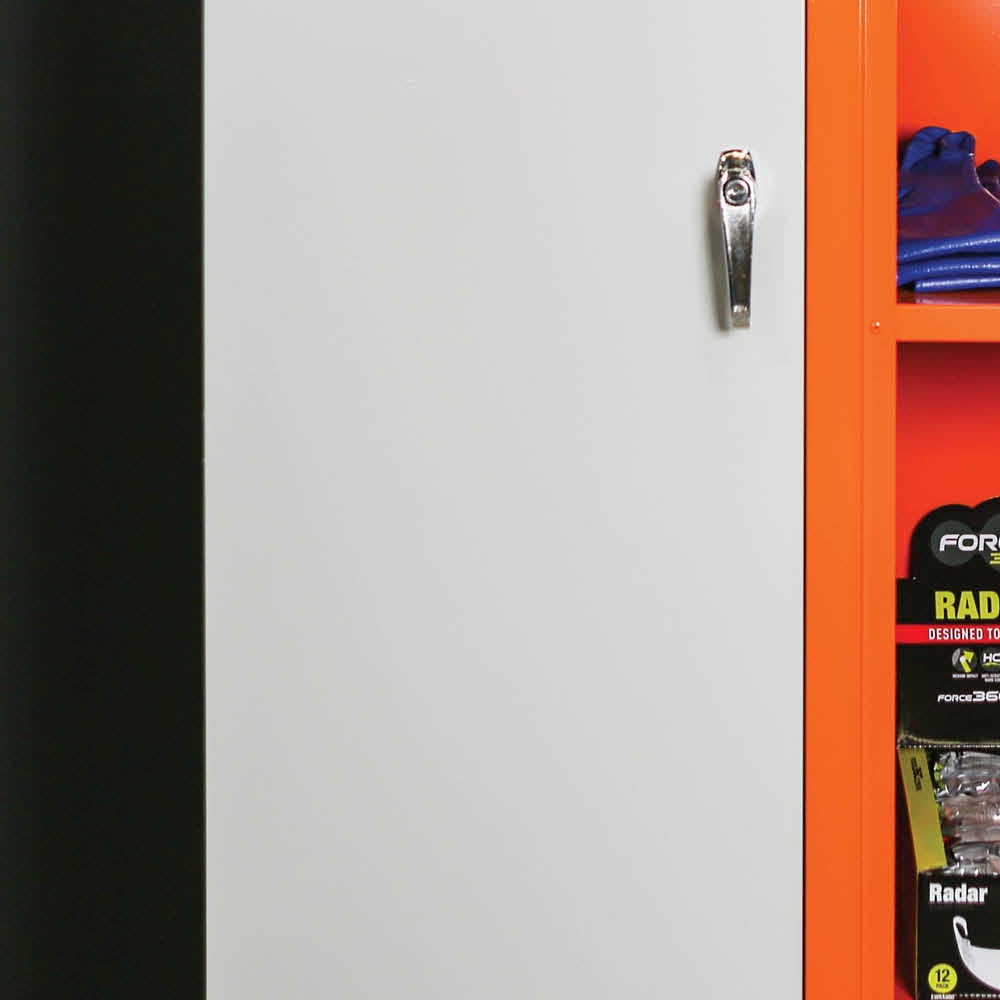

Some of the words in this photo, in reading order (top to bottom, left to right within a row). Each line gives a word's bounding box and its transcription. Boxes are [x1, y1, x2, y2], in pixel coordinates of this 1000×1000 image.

[928, 627, 984, 641] DESIGNED
[987, 627, 1000, 640] TO
[929, 882, 989, 903] Radar
[935, 968, 950, 983] 12
